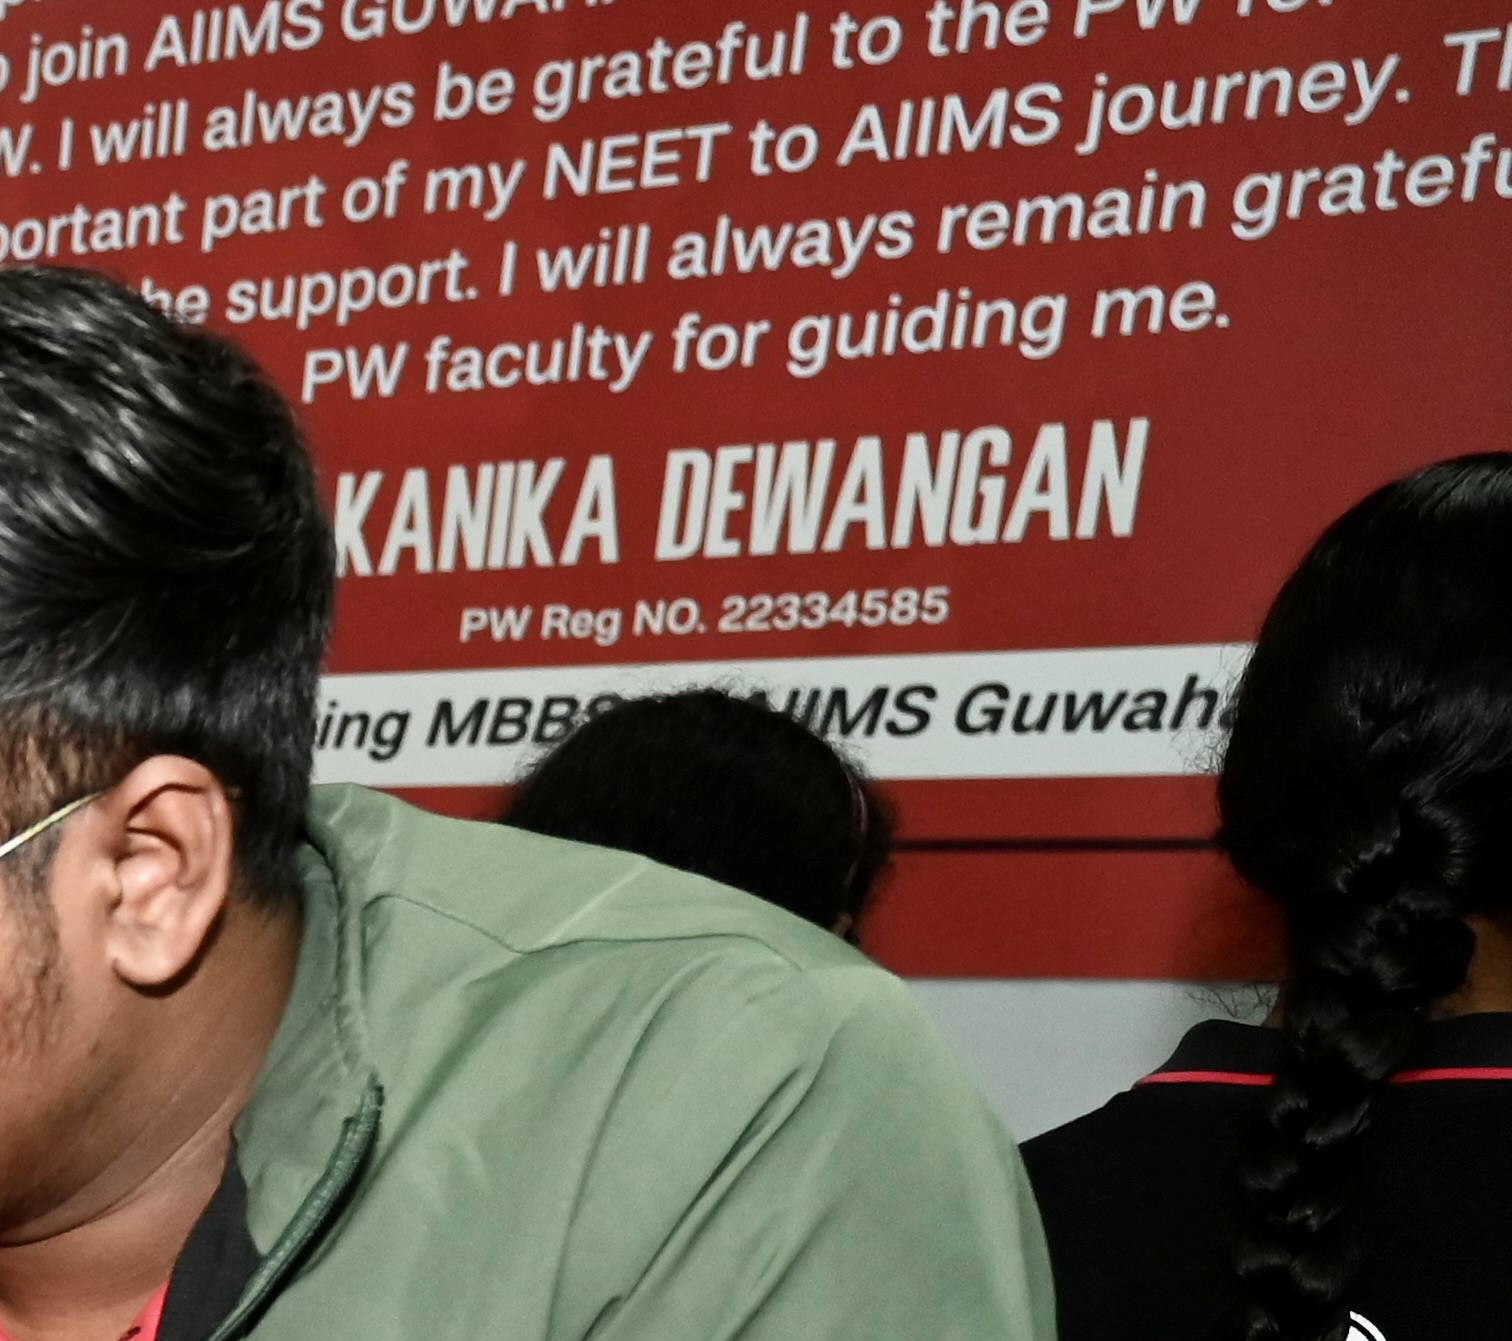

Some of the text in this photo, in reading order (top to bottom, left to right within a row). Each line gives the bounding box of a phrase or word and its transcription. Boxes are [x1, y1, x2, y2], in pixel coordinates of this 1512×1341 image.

[20, 25, 128, 103] join
[144, 0, 323, 71] AIIMS
[59, 119, 73, 170] I
[90, 99, 188, 165] will
[204, 82, 414, 150] always
[434, 62, 514, 120] be
[534, 13, 808, 122] grateful
[831, 12, 901, 68] to
[926, 0, 1049, 56] the
[201, 176, 326, 252] part
[343, 160, 408, 222] of
[424, 160, 525, 221] my
[544, 122, 732, 199] NEET
[749, 120, 818, 175] to
[837, 83, 1062, 166] AIIMS
[1076, 54, 1409, 154] journey.
[226, 249, 477, 330] support.
[500, 241, 516, 295] I
[537, 224, 650, 291] will
[668, 211, 914, 279] always
[938, 169, 1206, 253] remain
[302, 282, 1229, 403] PW faculty for guiding me.
[335, 417, 1149, 577] KANIKA DEWANGAN
[460, 586, 948, 646] PW Reg NO. 22334585
